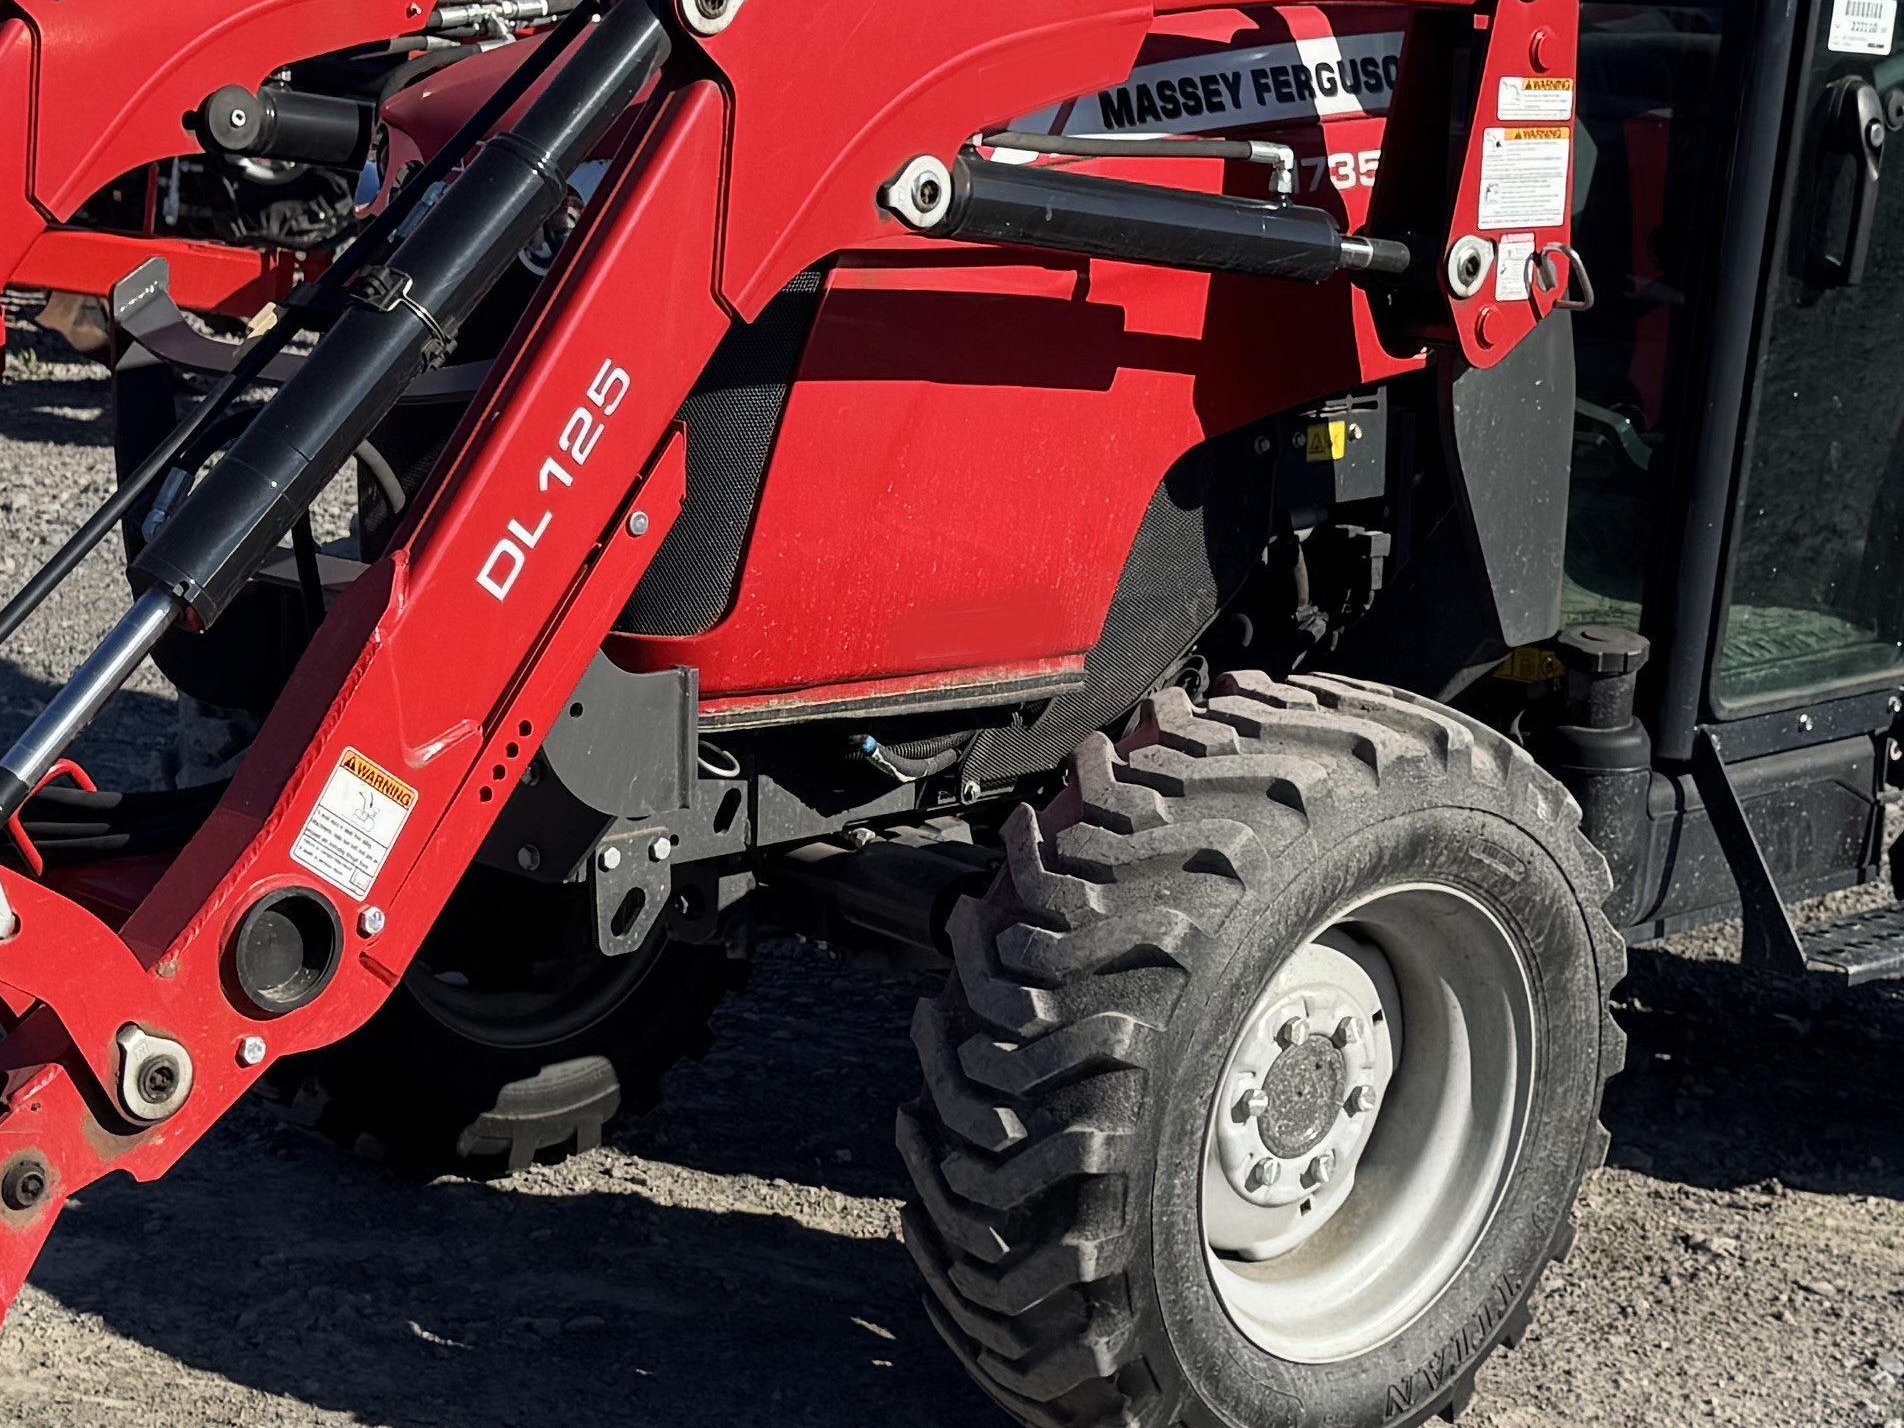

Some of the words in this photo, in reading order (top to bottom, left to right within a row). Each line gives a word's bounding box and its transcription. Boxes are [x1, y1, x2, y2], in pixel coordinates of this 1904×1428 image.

[1098, 71, 1242, 130] MASSEY
[1250, 55, 1400, 107] FERGUSO
[1295, 149, 1382, 193] 735
[476, 509, 553, 602] DL
[539, 358, 631, 492] 125
[356, 761, 412, 807] WARNING
